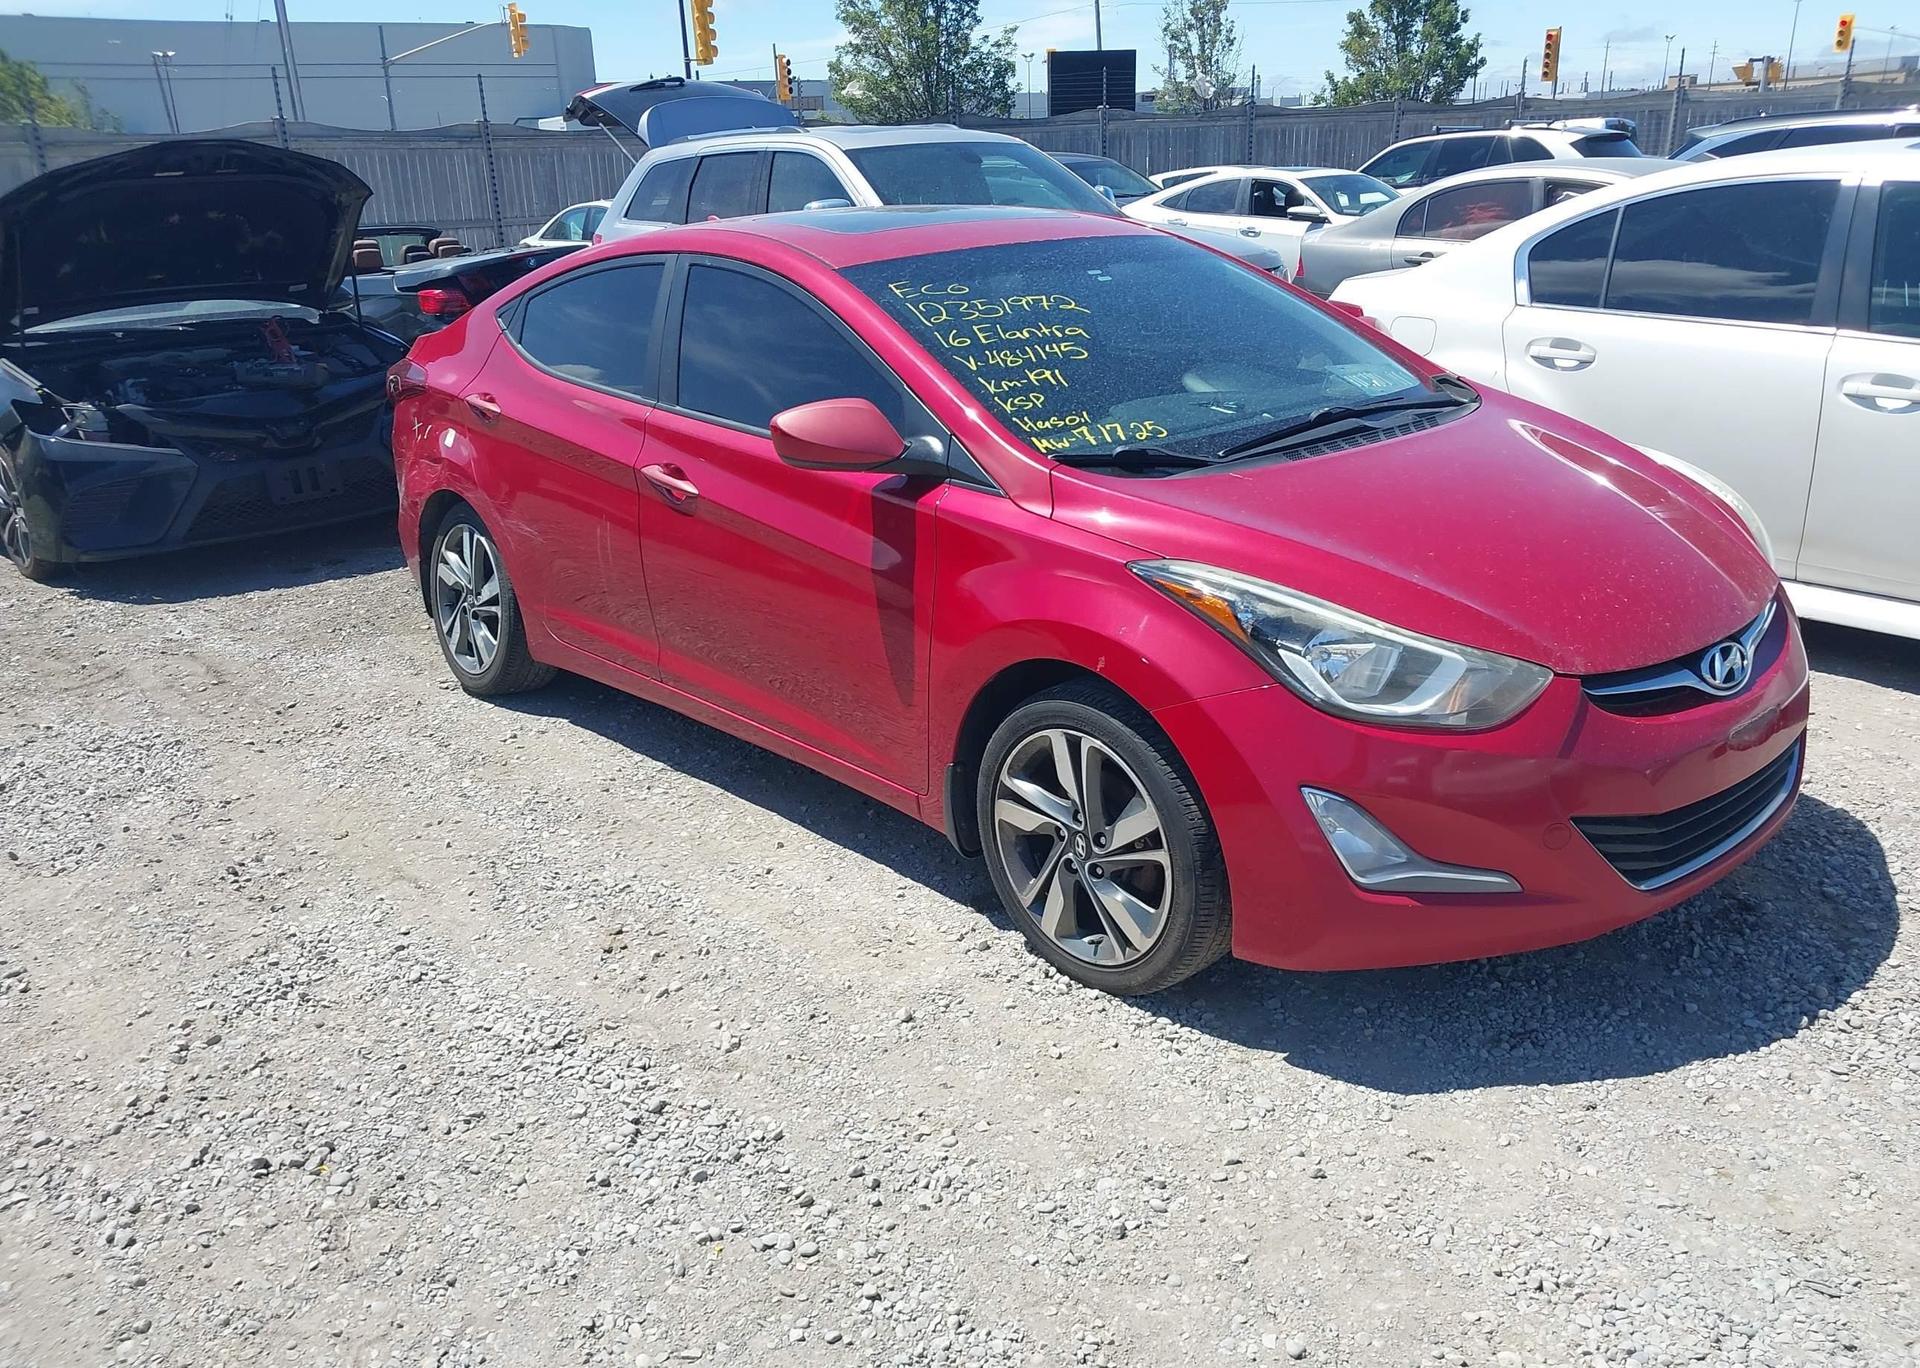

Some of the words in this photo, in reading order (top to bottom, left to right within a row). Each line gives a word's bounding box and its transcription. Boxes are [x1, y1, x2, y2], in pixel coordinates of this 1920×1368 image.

[905, 295, 1091, 326] 12351972
[934, 330, 971, 348] 16
[972, 322, 1091, 344] Elantra
